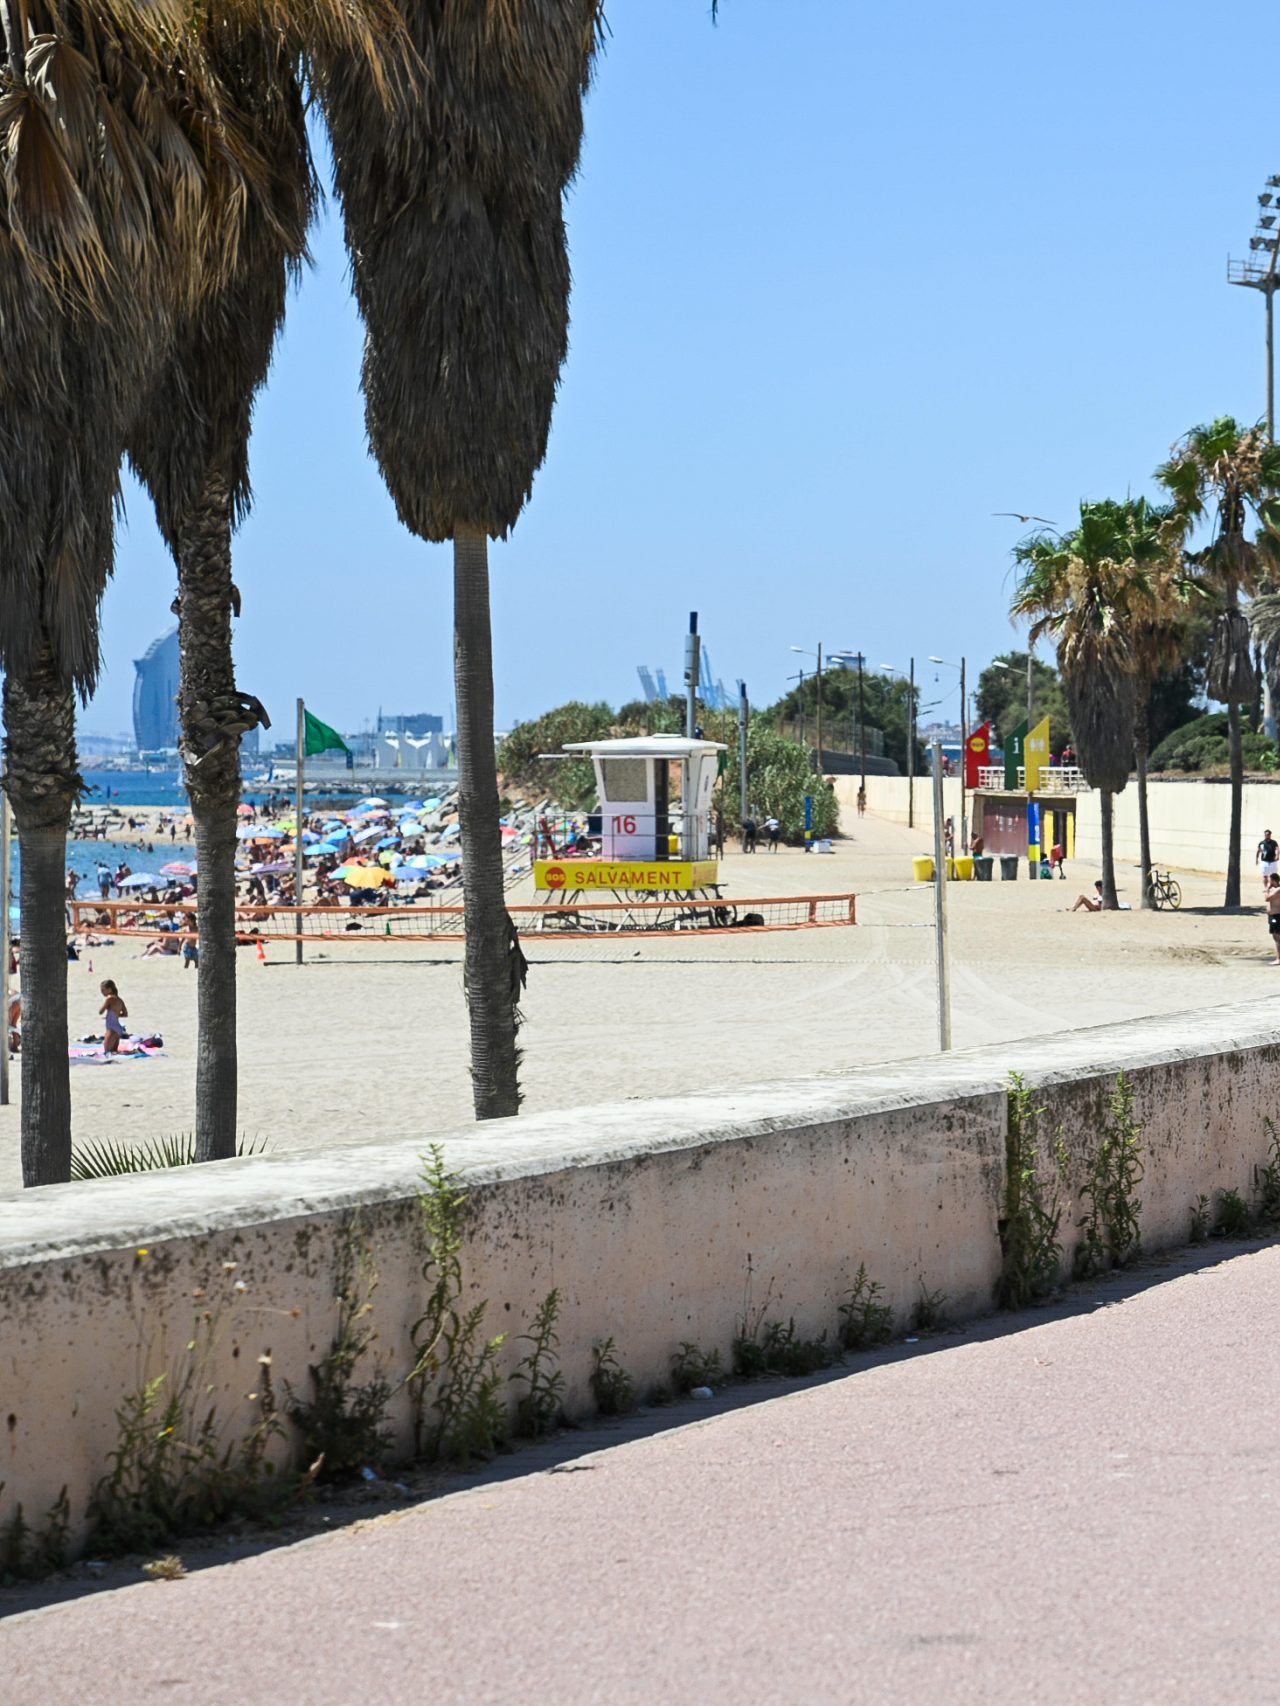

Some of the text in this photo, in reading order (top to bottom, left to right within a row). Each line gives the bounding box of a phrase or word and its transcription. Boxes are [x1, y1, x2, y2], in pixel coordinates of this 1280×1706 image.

[613, 815, 636, 834] 16
[546, 871, 682, 885] SOS SALVAMENT
